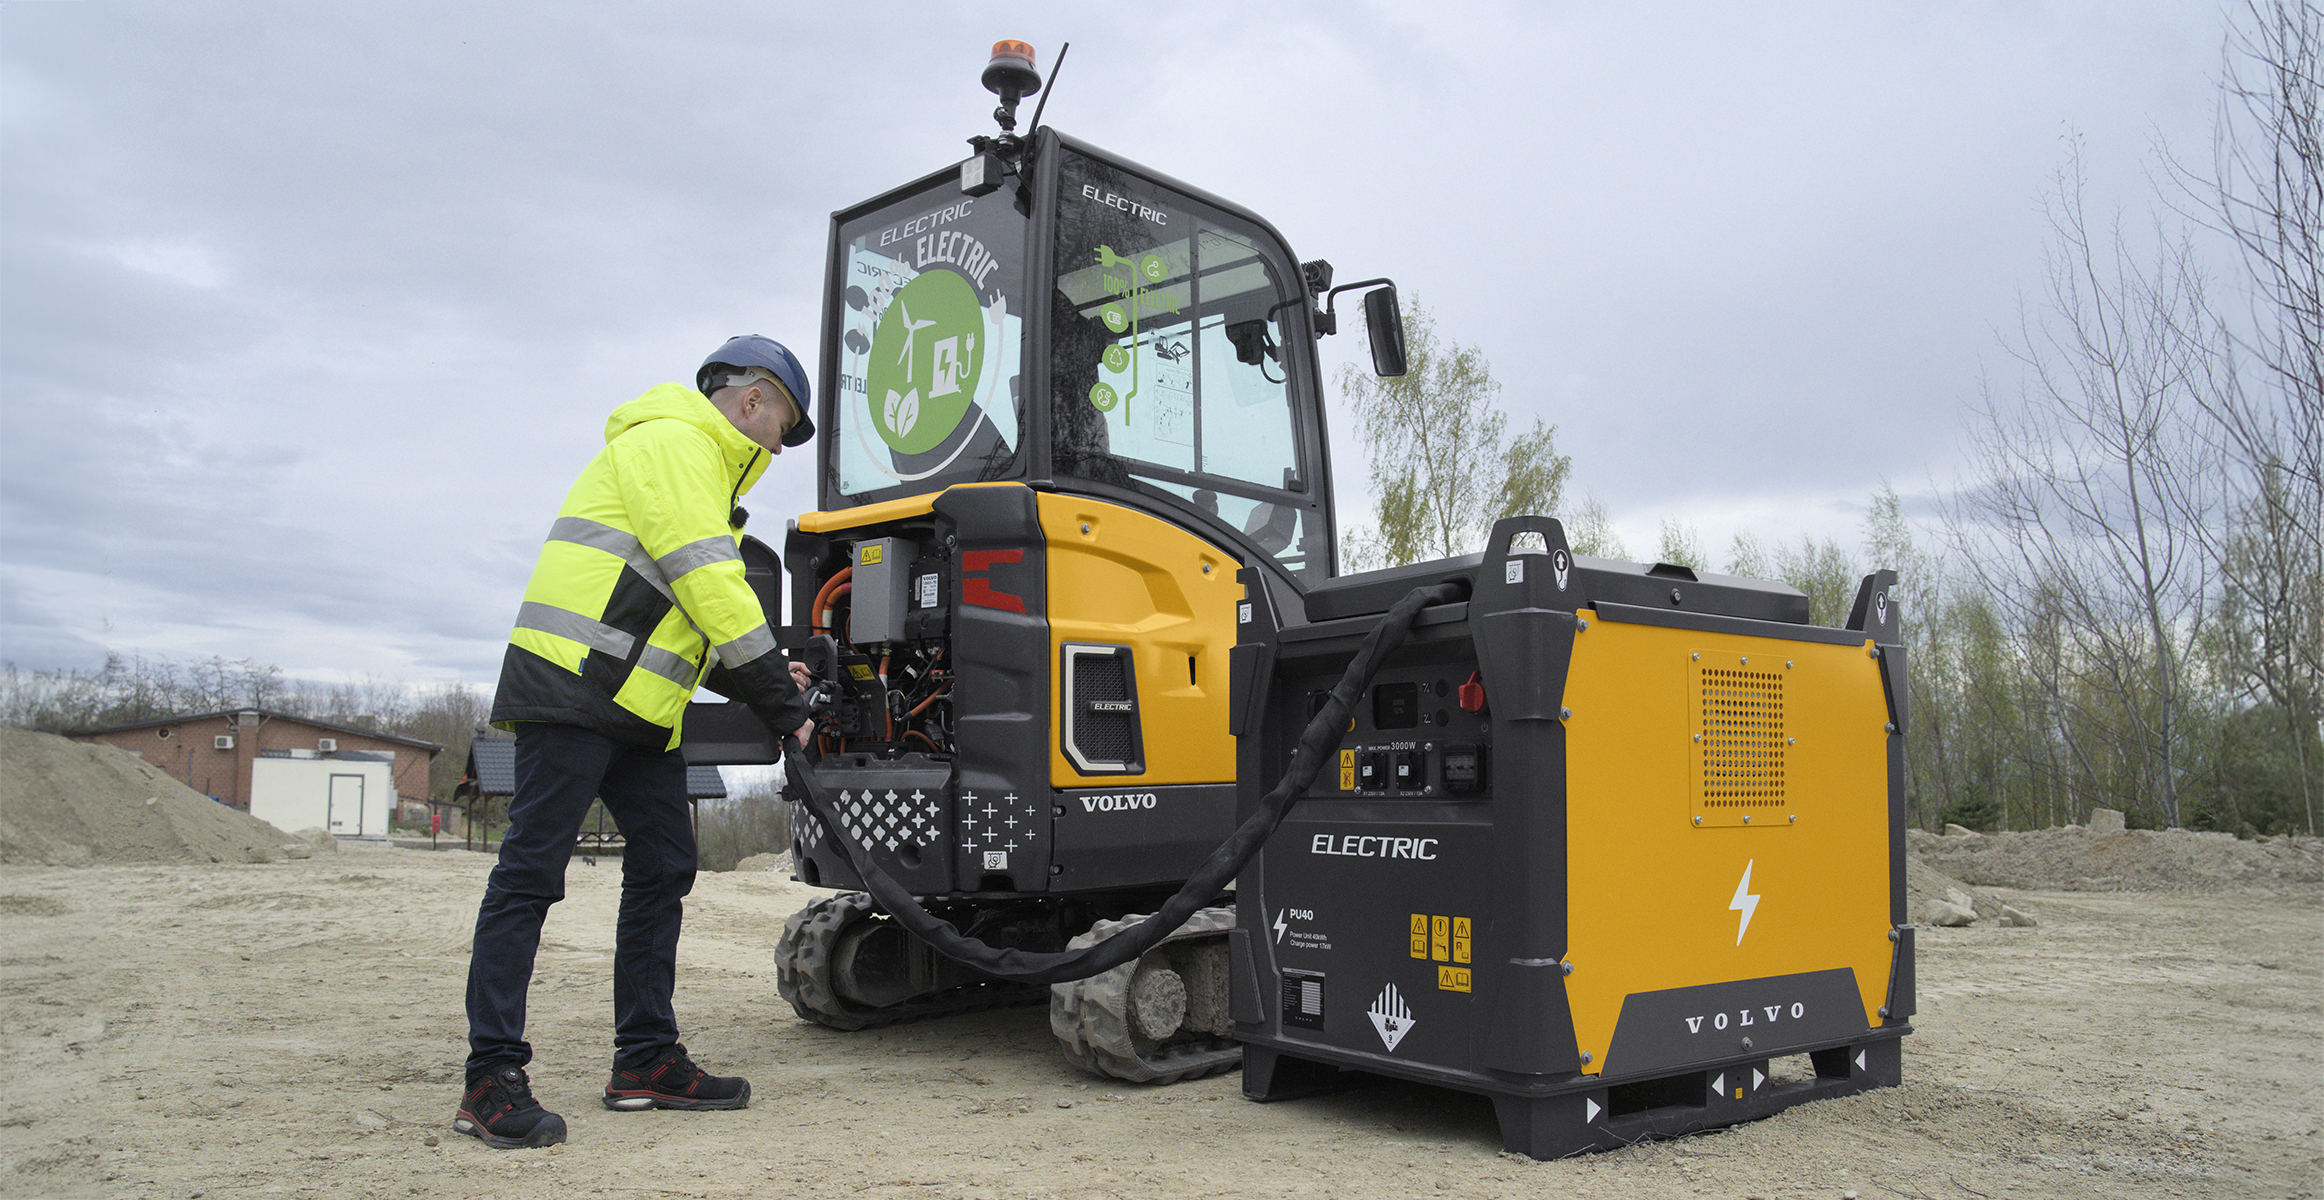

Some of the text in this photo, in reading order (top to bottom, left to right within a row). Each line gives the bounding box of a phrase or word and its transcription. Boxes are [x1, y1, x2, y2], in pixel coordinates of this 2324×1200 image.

[1082, 184, 1167, 226] ELECTRIC
[880, 199, 973, 247] ELECTRIC
[861, 230, 999, 323] 100% ELECTRIC
[1103, 273, 1181, 316] 100% ELECTRIC
[1094, 703, 1132, 711] ELECTRIC
[1391, 741, 1416, 751] 3000W
[1079, 793, 1157, 812] VOLVO
[1311, 834, 1438, 860] ELECTRIC
[1290, 908, 1314, 921] PU40
[1290, 940, 1305, 949] Charge
[1685, 1002, 1805, 1034] VOLVO
